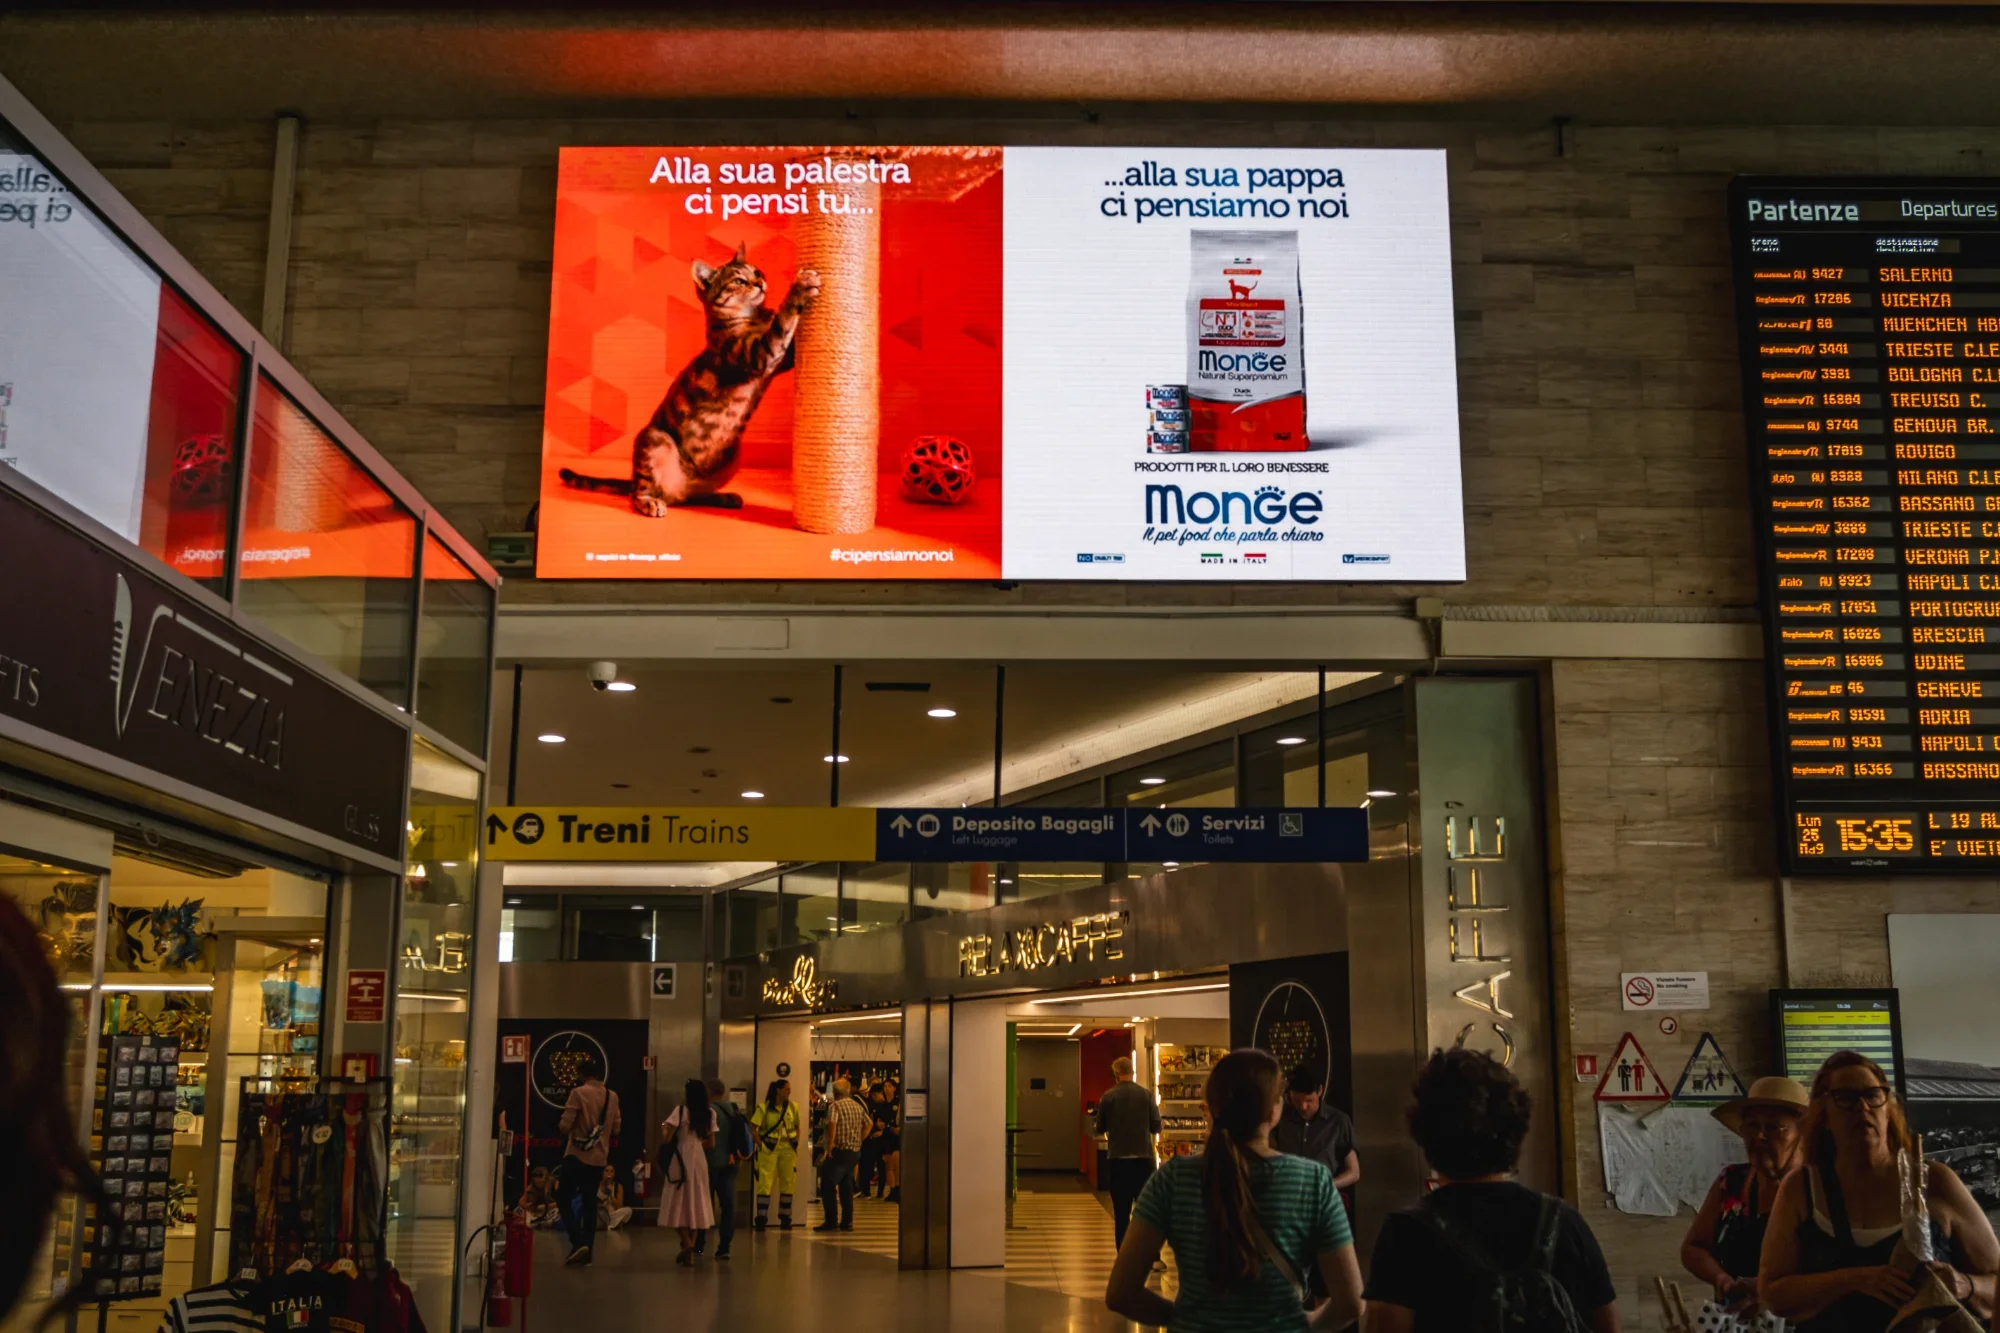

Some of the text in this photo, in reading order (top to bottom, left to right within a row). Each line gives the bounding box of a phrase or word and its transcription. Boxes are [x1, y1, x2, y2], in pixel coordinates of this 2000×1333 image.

[649, 157, 911, 190] Alla sua palestra
[1104, 160, 1345, 194] ...alla sua pappa
[685, 187, 873, 221] ci pensi tu...
[1100, 191, 1350, 224] ci pensiamo noi
[1748, 199, 1998, 222] Partenze Departures
[1812, 268, 1844, 279] 9427
[1879, 267, 1953, 282] SALERNO
[1881, 293, 1952, 308] VICENZA
[1883, 317, 1968, 332] MUENCHEN
[1819, 343, 1849, 354] 3441
[1885, 343, 1954, 357] TRIESTE
[1198, 372, 1288, 382] Natural Superpremium
[1888, 367, 1962, 382] BOLOGNA
[1972, 367, 2000, 382] C.L
[1890, 393, 1960, 408] TREVISO
[1970, 393, 1987, 408] C.
[1826, 419, 1859, 430] 9744
[1893, 418, 1957, 433] GENOVA
[1967, 418, 1995, 433] BR.
[1895, 444, 1956, 459] ROVIGO
[1134, 462, 1330, 473] PRODOTTI PER IL LORO BENESSERE
[1897, 470, 1959, 485] MILANO
[1899, 496, 1975, 512] BASSANO
[1154, 527, 1178, 544] pet
[1178, 527, 1212, 546] food
[1213, 527, 1236, 541] che
[1236, 527, 1279, 545] parla
[1281, 527, 1324, 541] chiaro
[1902, 521, 1973, 538] TRIESTE
[829, 548, 954, 565] #cipensiamonoi
[1904, 548, 1970, 565] VERONA
[1907, 574, 1971, 590] NAPOLI
[1912, 627, 1985, 643] BRESCIA
[1914, 654, 1966, 670] UDINE
[1916, 681, 1983, 698] GENEVE
[1919, 709, 1971, 725] ADRIA
[1851, 736, 1883, 748] 9431
[1921, 735, 1984, 752] NAPOLI
[1853, 763, 1893, 776] 16366
[1923, 763, 2000, 779] BASSANO
[952, 815, 1115, 837] Deposito Bagagli
[1202, 814, 1266, 832] Servizi
[1796, 812, 1822, 827] Lun
[1928, 812, 1940, 829] L
[1951, 812, 1970, 829] 19
[558, 814, 750, 845] Treni Trains
[1802, 828, 1820, 842] 25
[1836, 819, 1914, 852] 15:35
[952, 834, 1019, 848] Left Luggage
[1202, 832, 1235, 845] Toilets
[271, 1295, 323, 1316] ITALIA
